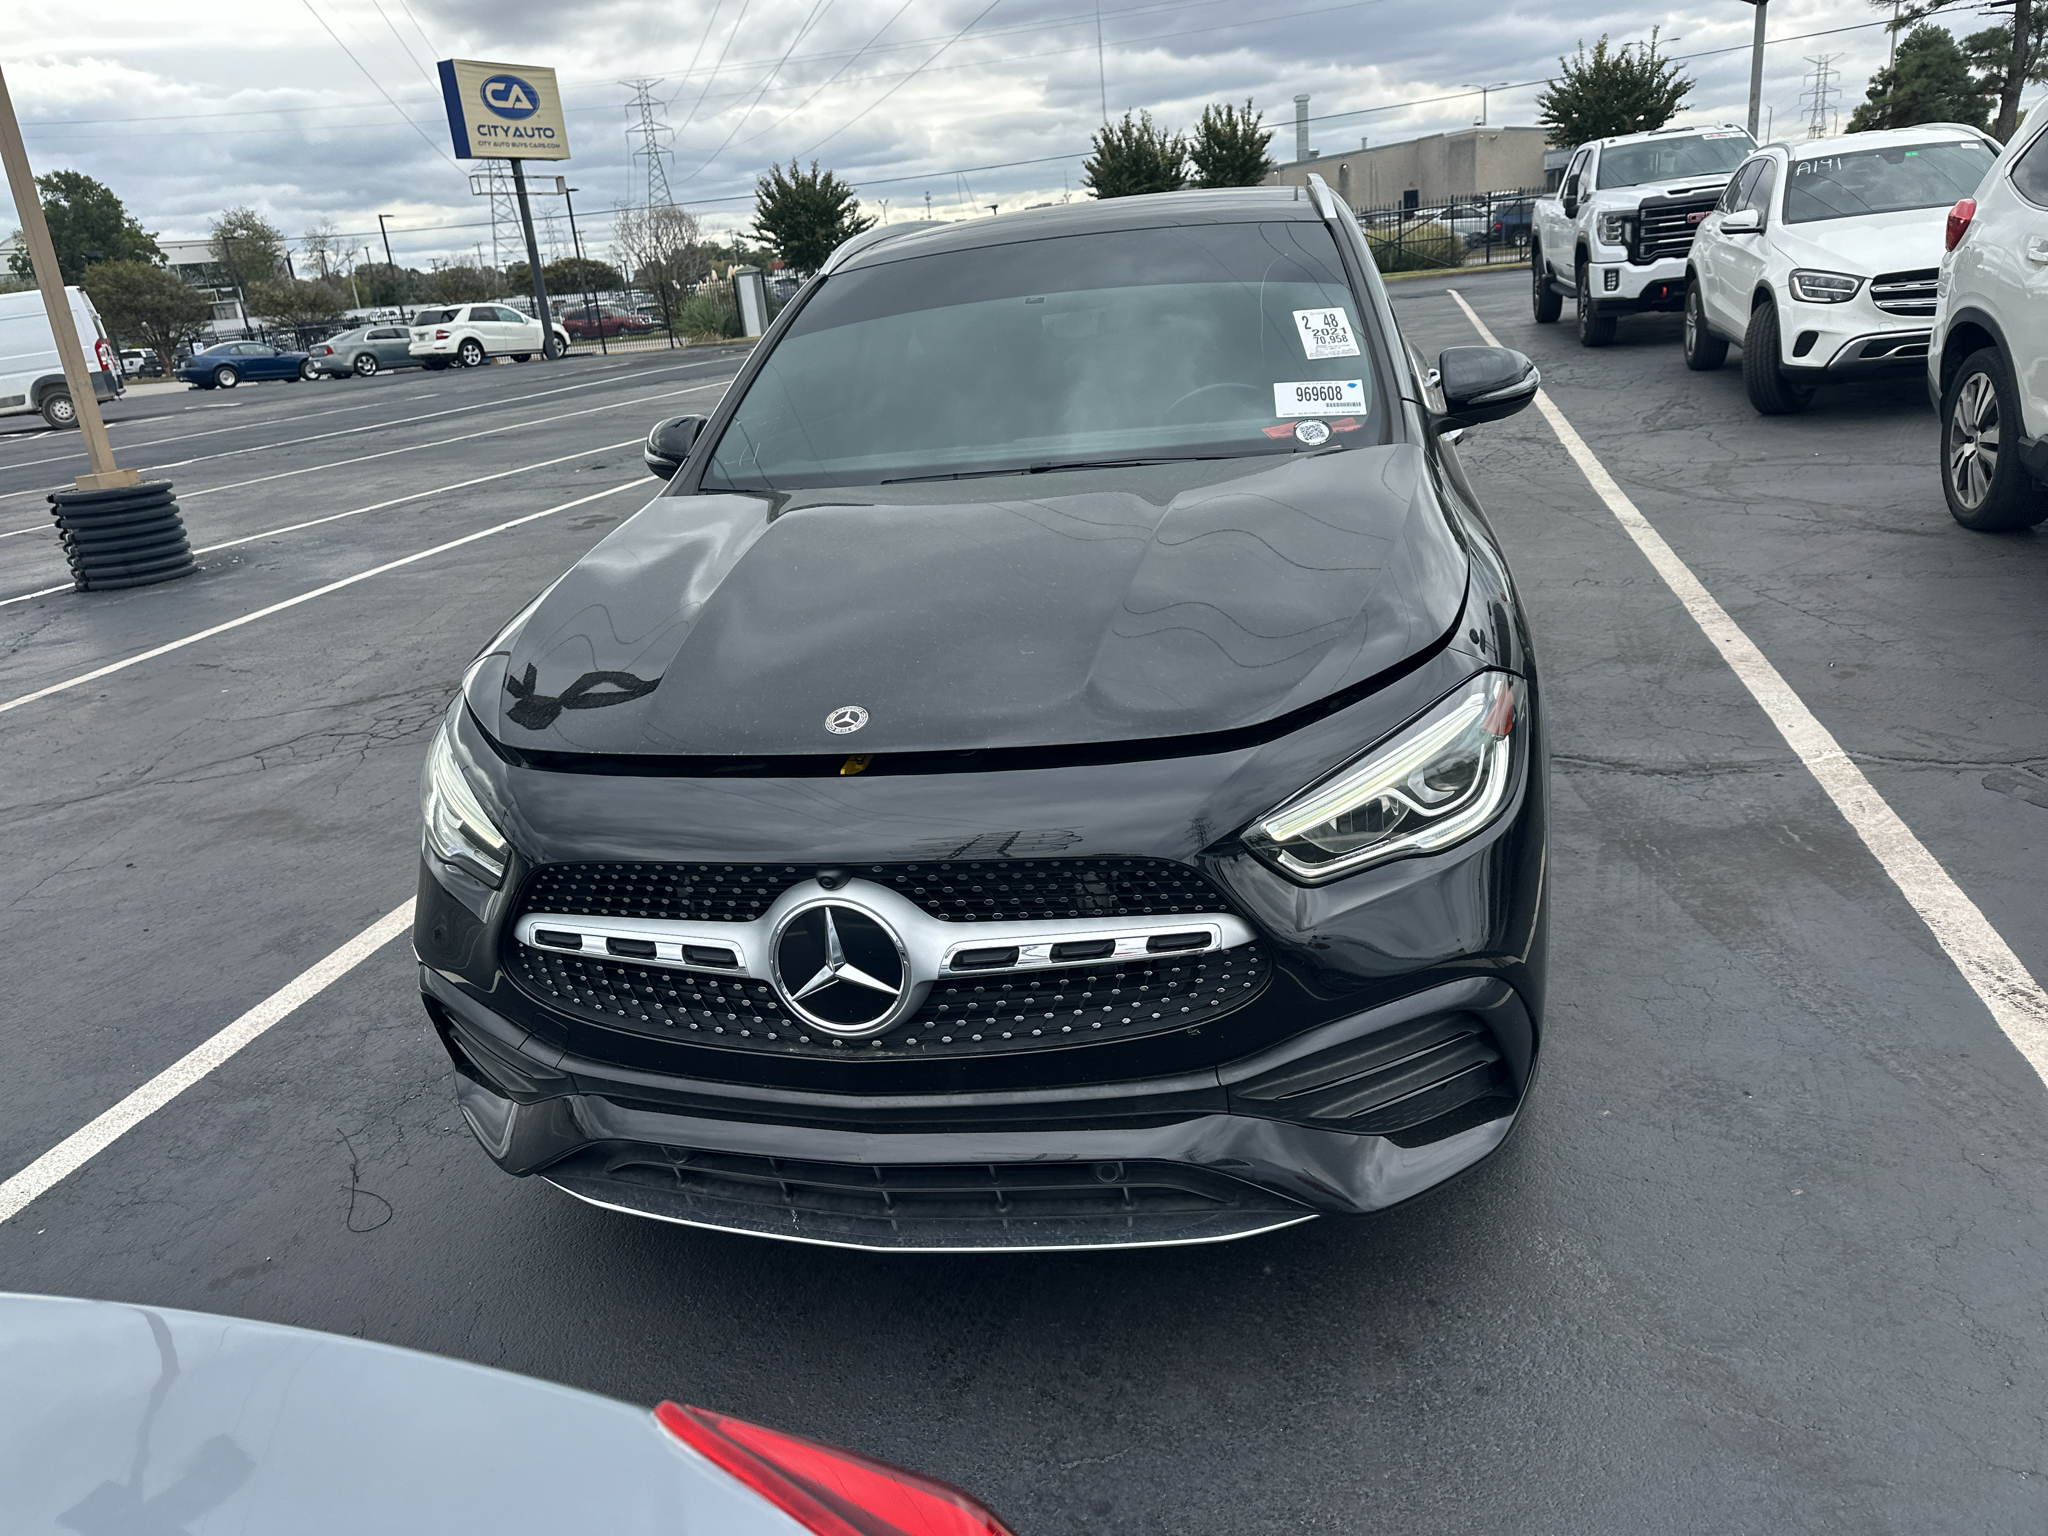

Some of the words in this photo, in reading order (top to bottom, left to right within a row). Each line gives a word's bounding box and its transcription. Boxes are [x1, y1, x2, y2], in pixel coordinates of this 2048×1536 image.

[485, 82, 534, 110] CA
[477, 124, 511, 138] CITY
[512, 126, 556, 139] AUTO
[1301, 315, 1312, 330] 2
[1323, 313, 1339, 328] 48
[1311, 327, 1347, 337] 2021
[1313, 335, 1349, 345] 70,958
[1296, 385, 1343, 402] 969608
